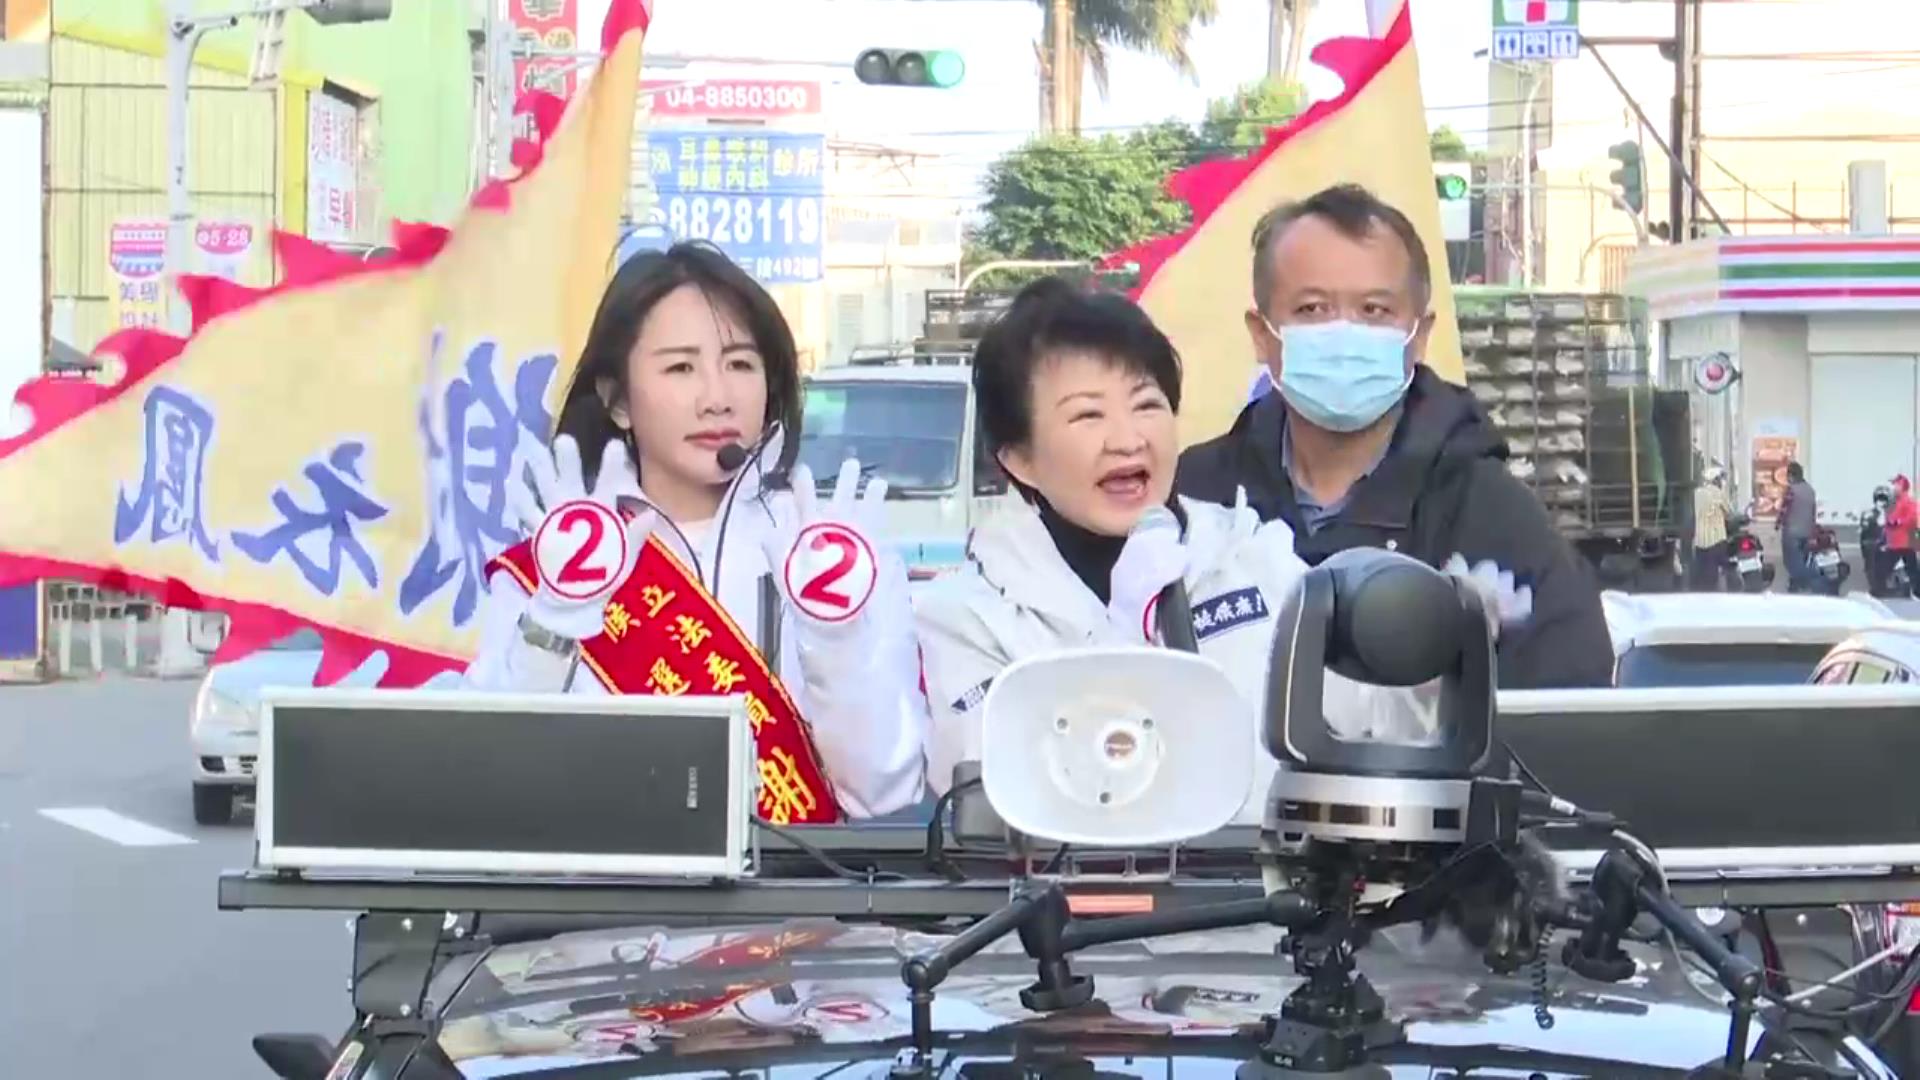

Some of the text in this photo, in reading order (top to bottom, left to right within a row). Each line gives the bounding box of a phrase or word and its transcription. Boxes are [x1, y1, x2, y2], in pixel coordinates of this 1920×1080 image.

[666, 87, 807, 109] 04-8850300
[670, 198, 818, 243] 8828119
[641, 584, 777, 735] 立法委員
